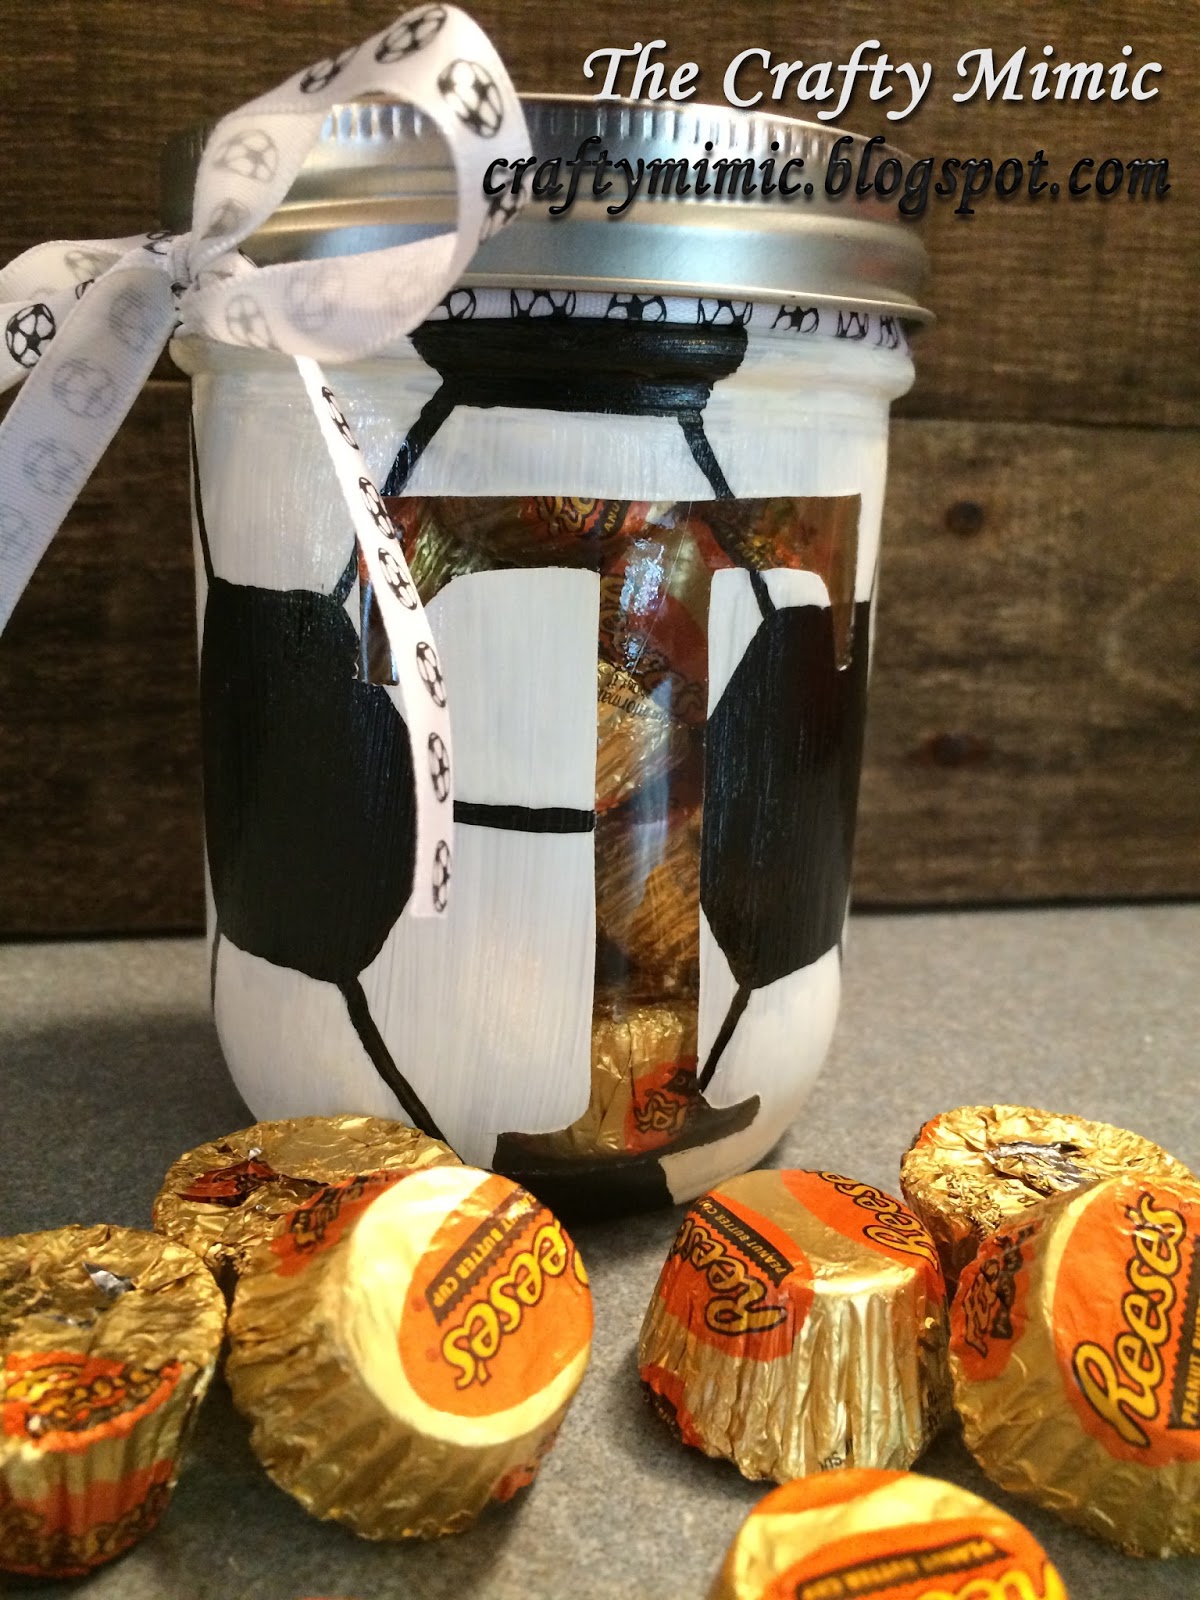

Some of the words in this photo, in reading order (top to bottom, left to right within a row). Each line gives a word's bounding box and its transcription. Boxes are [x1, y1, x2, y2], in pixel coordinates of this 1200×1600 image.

[714, 1213, 751, 1242] BUTTER
[456, 1227, 505, 1279] BUTTER
[745, 1240, 788, 1274] PEANUT
[432, 1276, 459, 1308] CUP
[440, 1217, 590, 1390] eese's
[1072, 1191, 1187, 1447] Reese's
